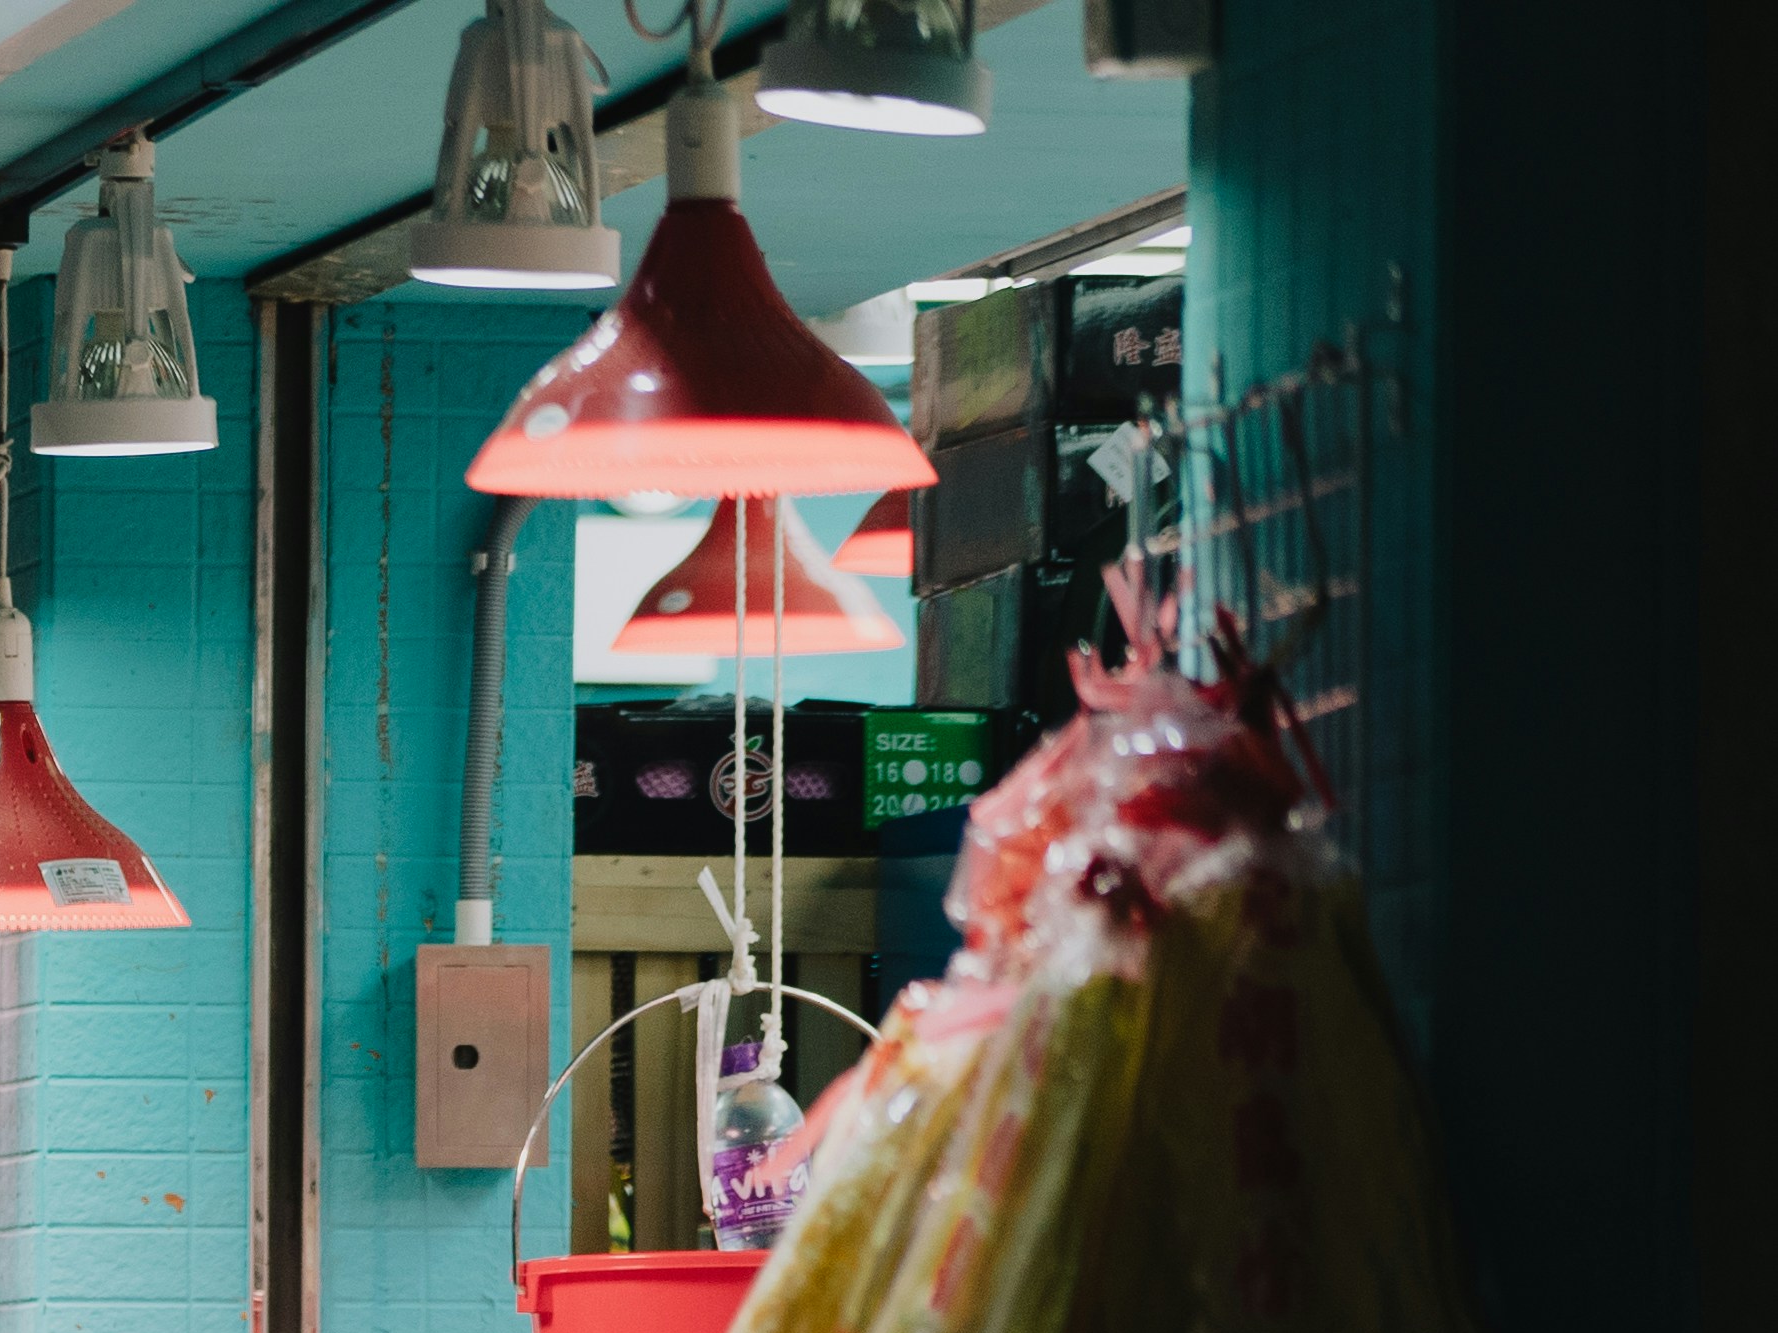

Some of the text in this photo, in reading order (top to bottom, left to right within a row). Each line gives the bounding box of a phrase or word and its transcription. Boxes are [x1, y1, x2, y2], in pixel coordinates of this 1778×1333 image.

[876, 733, 937, 751] SIZE:
[875, 761, 955, 783] 16 18
[873, 795, 900, 816] 20
